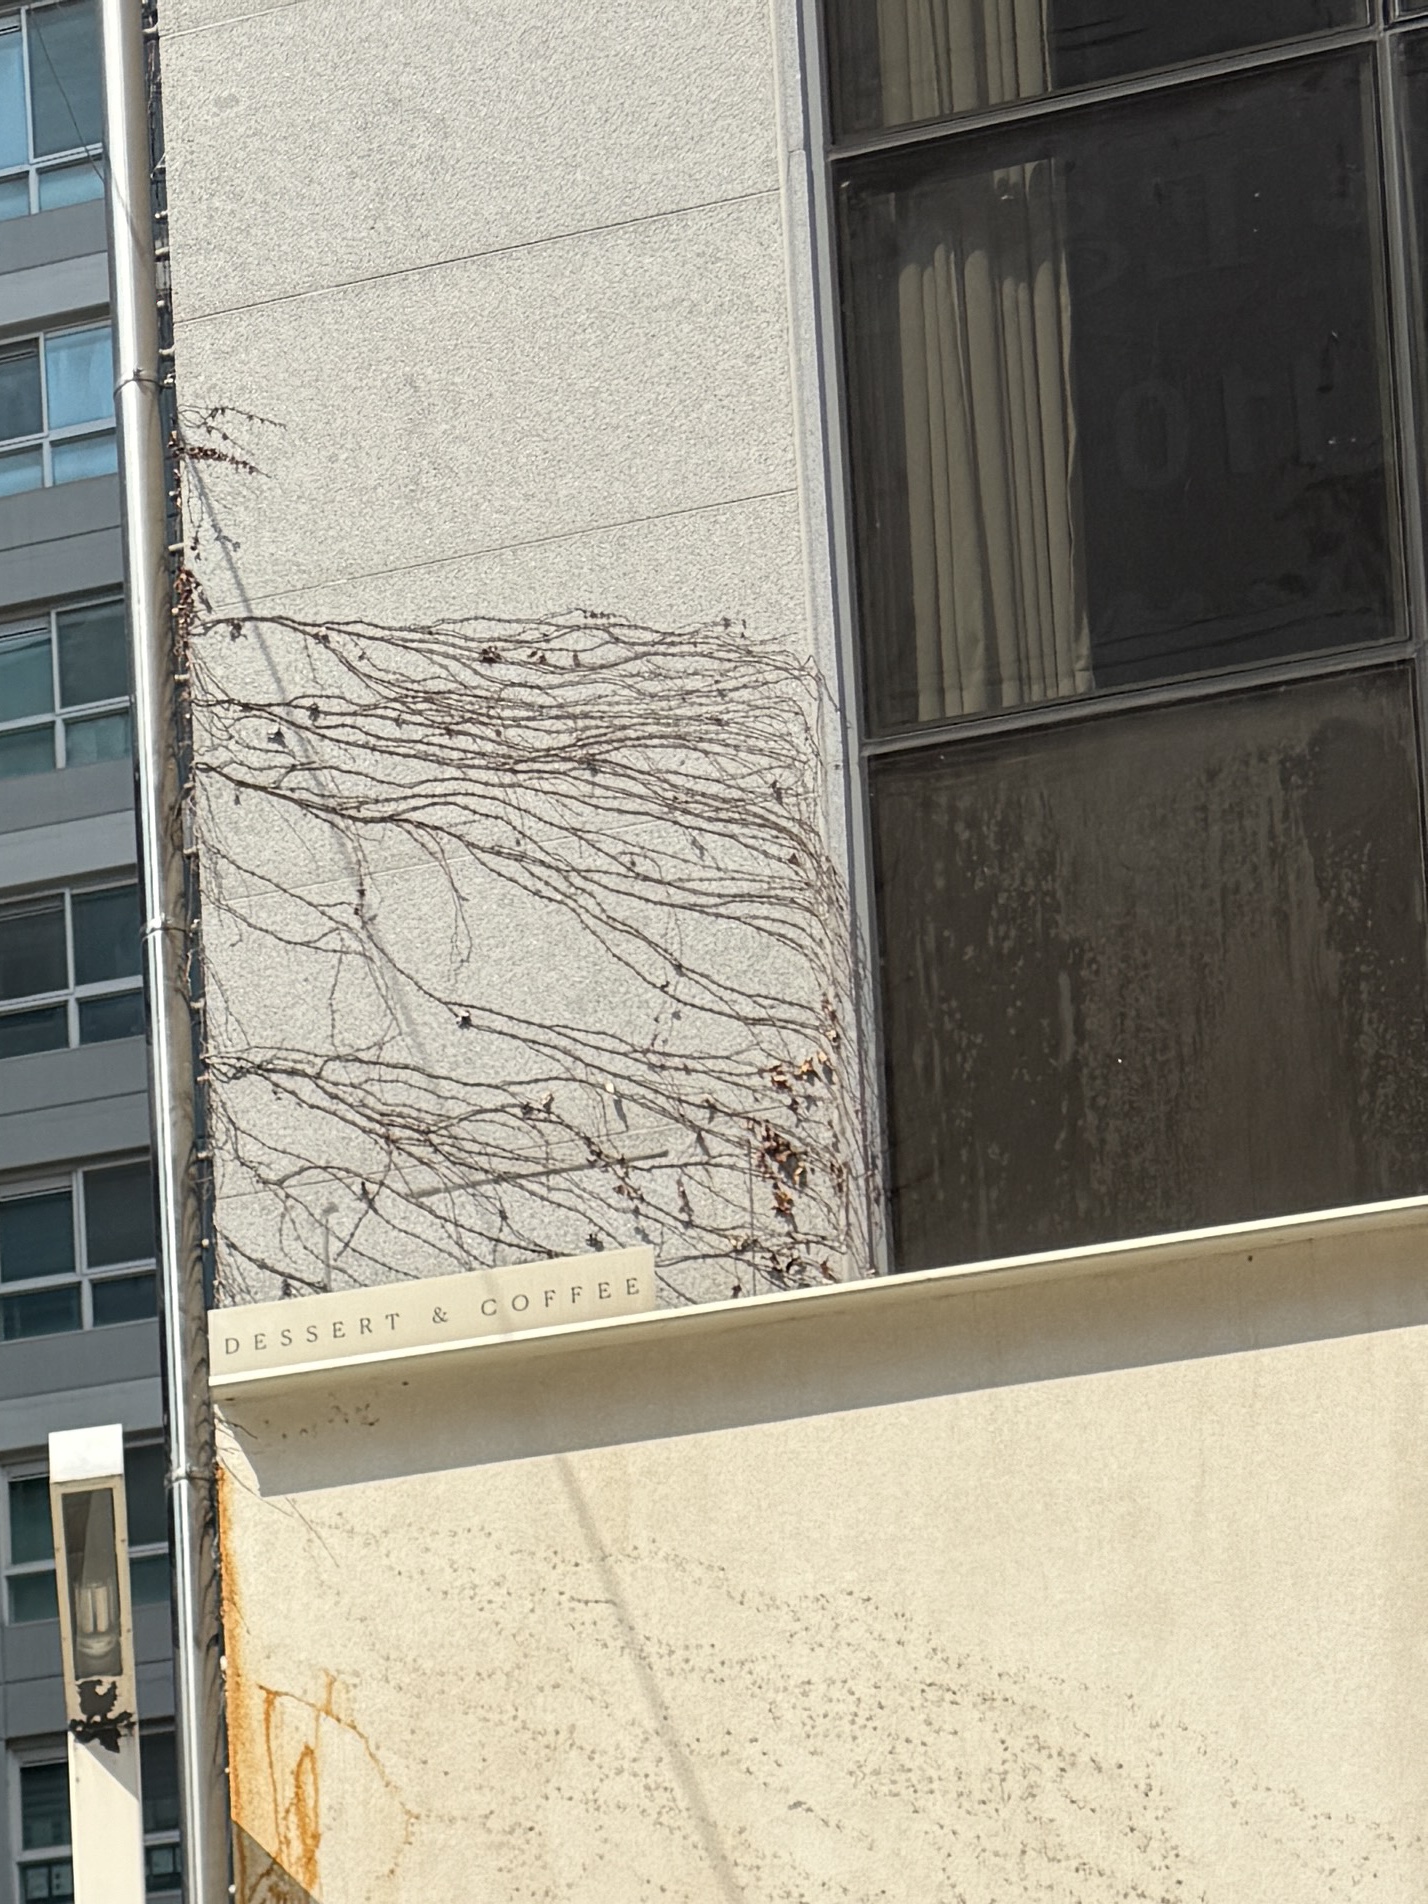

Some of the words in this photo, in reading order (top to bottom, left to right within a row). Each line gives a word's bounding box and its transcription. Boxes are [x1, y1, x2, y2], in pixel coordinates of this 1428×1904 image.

[224, 1312, 400, 1355] DESSERT
[432, 1306, 448, 1324] &
[480, 1277, 640, 1316] COFFEE
